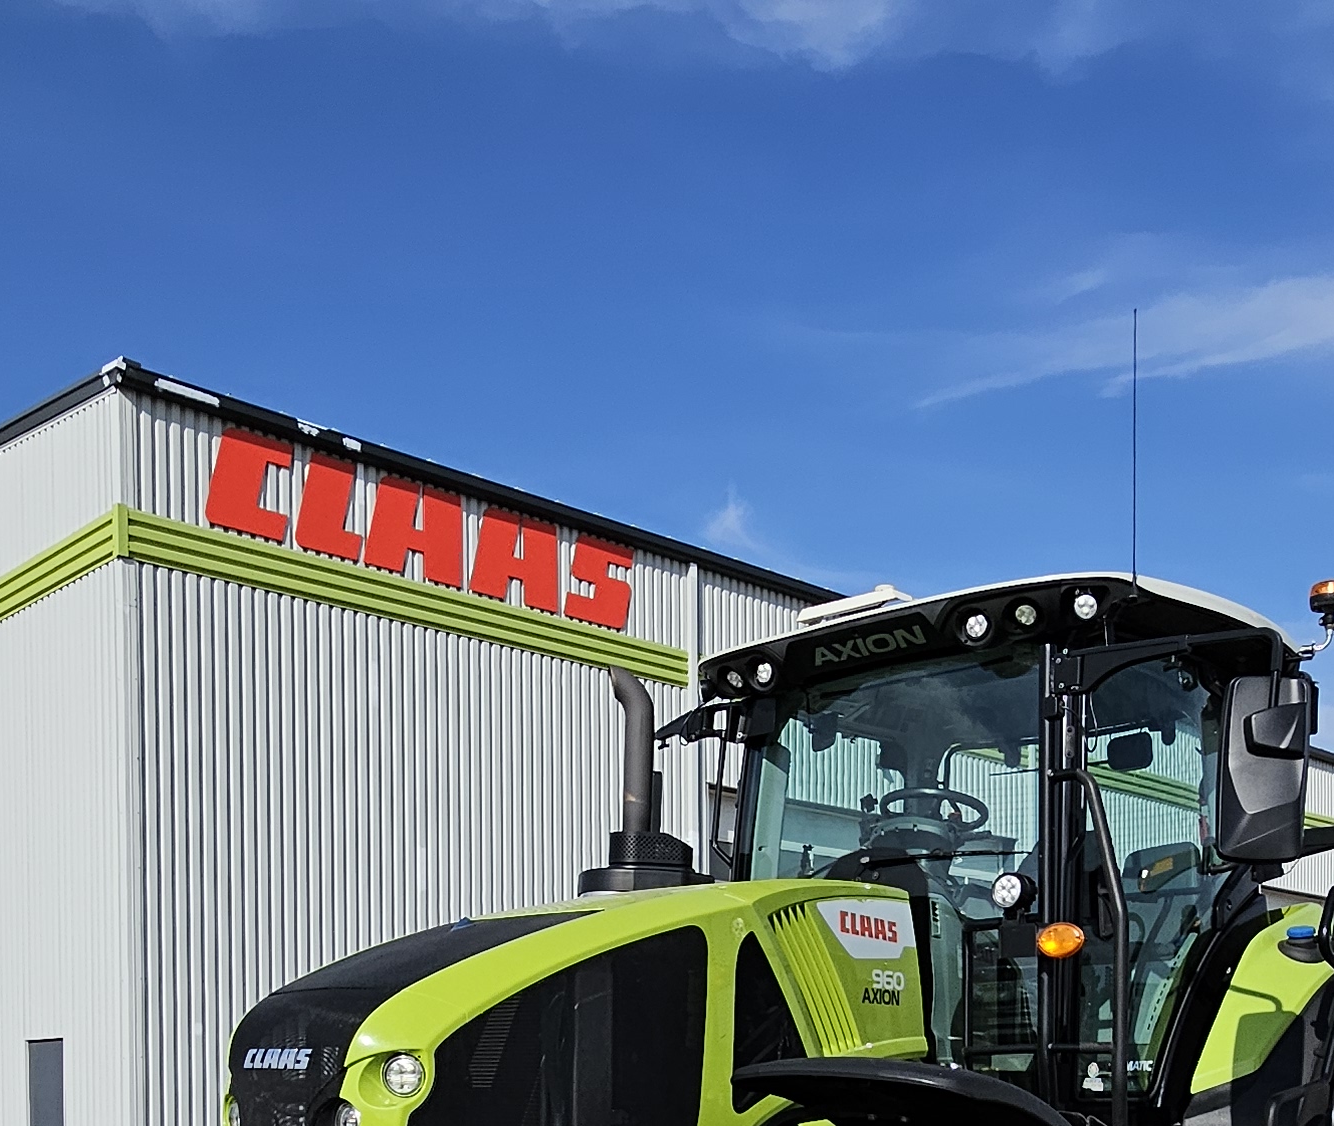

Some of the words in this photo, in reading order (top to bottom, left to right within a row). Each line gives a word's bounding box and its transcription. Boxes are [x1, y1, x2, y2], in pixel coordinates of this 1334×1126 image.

[205, 428, 634, 629] CLAAS
[814, 625, 926, 667] AXION
[840, 911, 897, 943] CLAAS
[872, 969, 905, 991] 960
[862, 988, 900, 1006] AXION
[244, 1049, 312, 1069] CLAAS
[1126, 1060, 1154, 1072] MATIC
